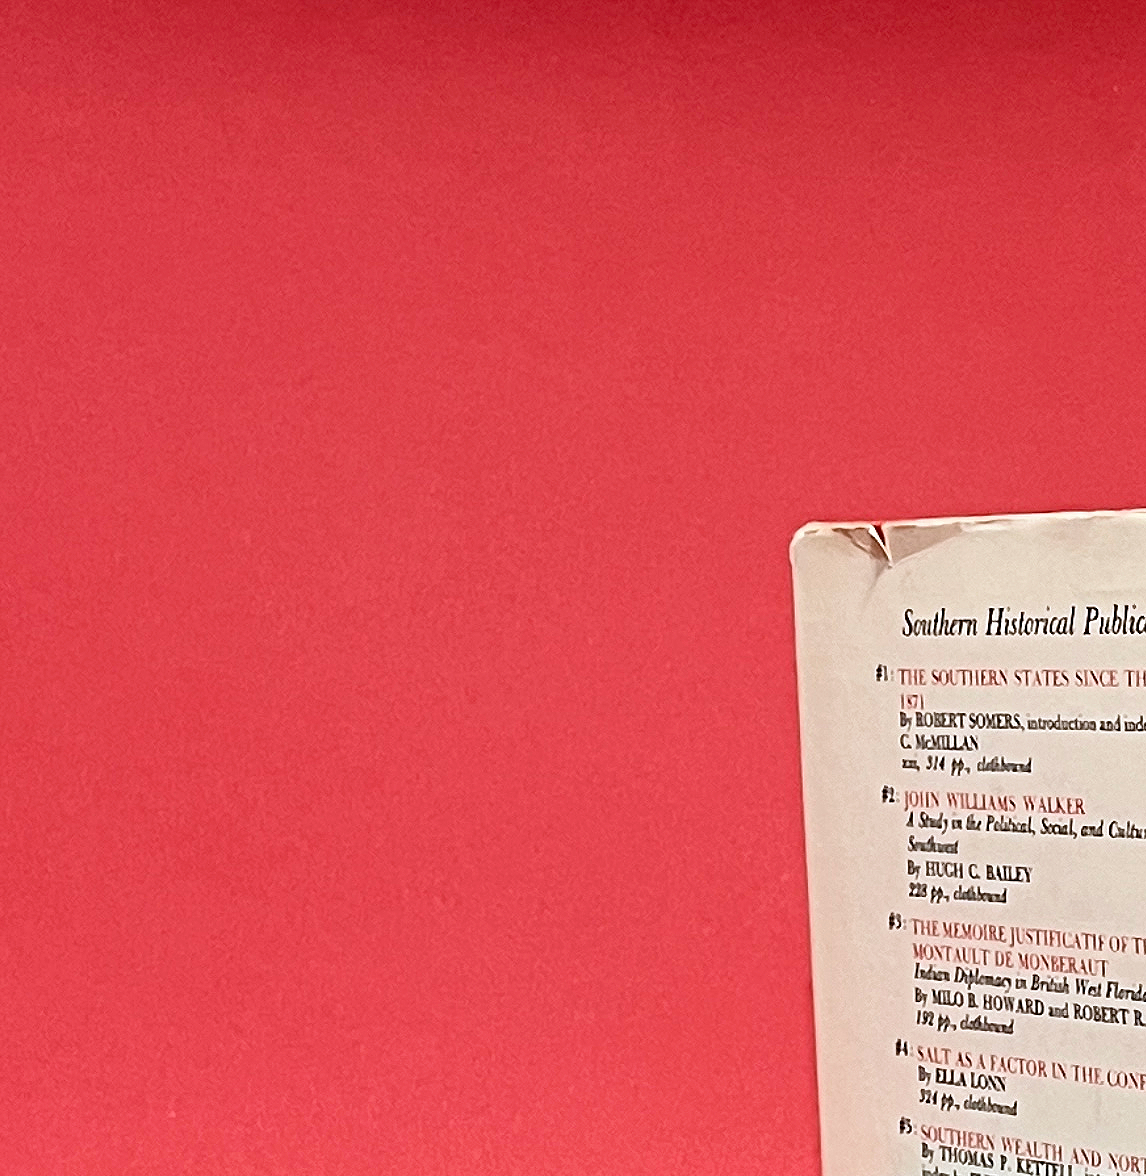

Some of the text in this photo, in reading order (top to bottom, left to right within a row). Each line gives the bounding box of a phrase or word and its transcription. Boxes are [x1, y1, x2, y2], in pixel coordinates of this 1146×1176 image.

[902, 608, 977, 637] Southern
[985, 606, 1076, 636] Historical
[898, 669, 926, 685] THE
[931, 669, 1008, 686] SOUTHERN
[1014, 670, 1069, 687] STATES
[1075, 669, 1118, 687] SINCE
[900, 694, 924, 709] 1871
[900, 713, 912, 730] By
[915, 713, 965, 729] ROBERT
[969, 714, 1025, 731] SOMERS,
[1027, 713, 1096, 731] introduction
[1100, 716, 1121, 732] and
[900, 734, 978, 751] C. McMILLAN
[925, 756, 945, 772] 314
[977, 757, 1031, 773] clothbound
[904, 791, 939, 812] JOHN
[947, 793, 1016, 813] WILLIAMS
[1023, 796, 1085, 815] WALKER
[906, 812, 915, 828] A
[918, 811, 948, 835] Study
[966, 813, 982, 831] the
[986, 814, 1036, 836] Political,
[1040, 819, 1077, 840] Social,
[1081, 821, 1104, 837] and
[907, 837, 958, 855] Southwest
[907, 860, 1033, 883] By HUGH C. BAILEY
[953, 886, 1006, 903] clothbound
[912, 919, 940, 937] THE
[942, 922, 1007, 943] MEMOIRE
[1010, 926, 1105, 951] JUSTIFICATIF
[1109, 936, 1126, 953] OF
[913, 943, 1109, 977] MONTAULT DE MONBERAUT
[915, 963, 950, 981] Indian
[955, 967, 1012, 994] Diplomacy
[1030, 974, 1069, 996] British
[1075, 978, 1102, 998] West
[915, 988, 928, 1007] By
[931, 989, 964, 1007] MILO
[968, 992, 980, 1008] B.
[983, 994, 1044, 1016] HOWARD
[1048, 1002, 1069, 1019] and
[1073, 1003, 1127, 1024] ROBERT
[1131, 1009, 1146, 1026] R.
[916, 1010, 934, 1027] 192
[960, 1014, 1014, 1034] clothbound
[917, 1046, 954, 1066] SALT
[958, 1051, 972, 1068] AS
[977, 1054, 987, 1070] A
[991, 1057, 1047, 1077] FACTOR
[1051, 1063, 1067, 1080] IN
[1070, 1065, 1104, 1085] THE
[918, 1066, 1006, 1092] By ELLA LONN
[919, 1090, 938, 1106] 324
[964, 1094, 1017, 1116] clothbound
[920, 1125, 995, 1150] SOUTHERN
[1000, 1135, 1062, 1161] WEALTH
[1070, 1149, 1102, 1167] AND
[922, 1144, 934, 1163] By
[939, 1146, 994, 1169] THOMAS
[1001, 1155, 1012, 1172] P.
